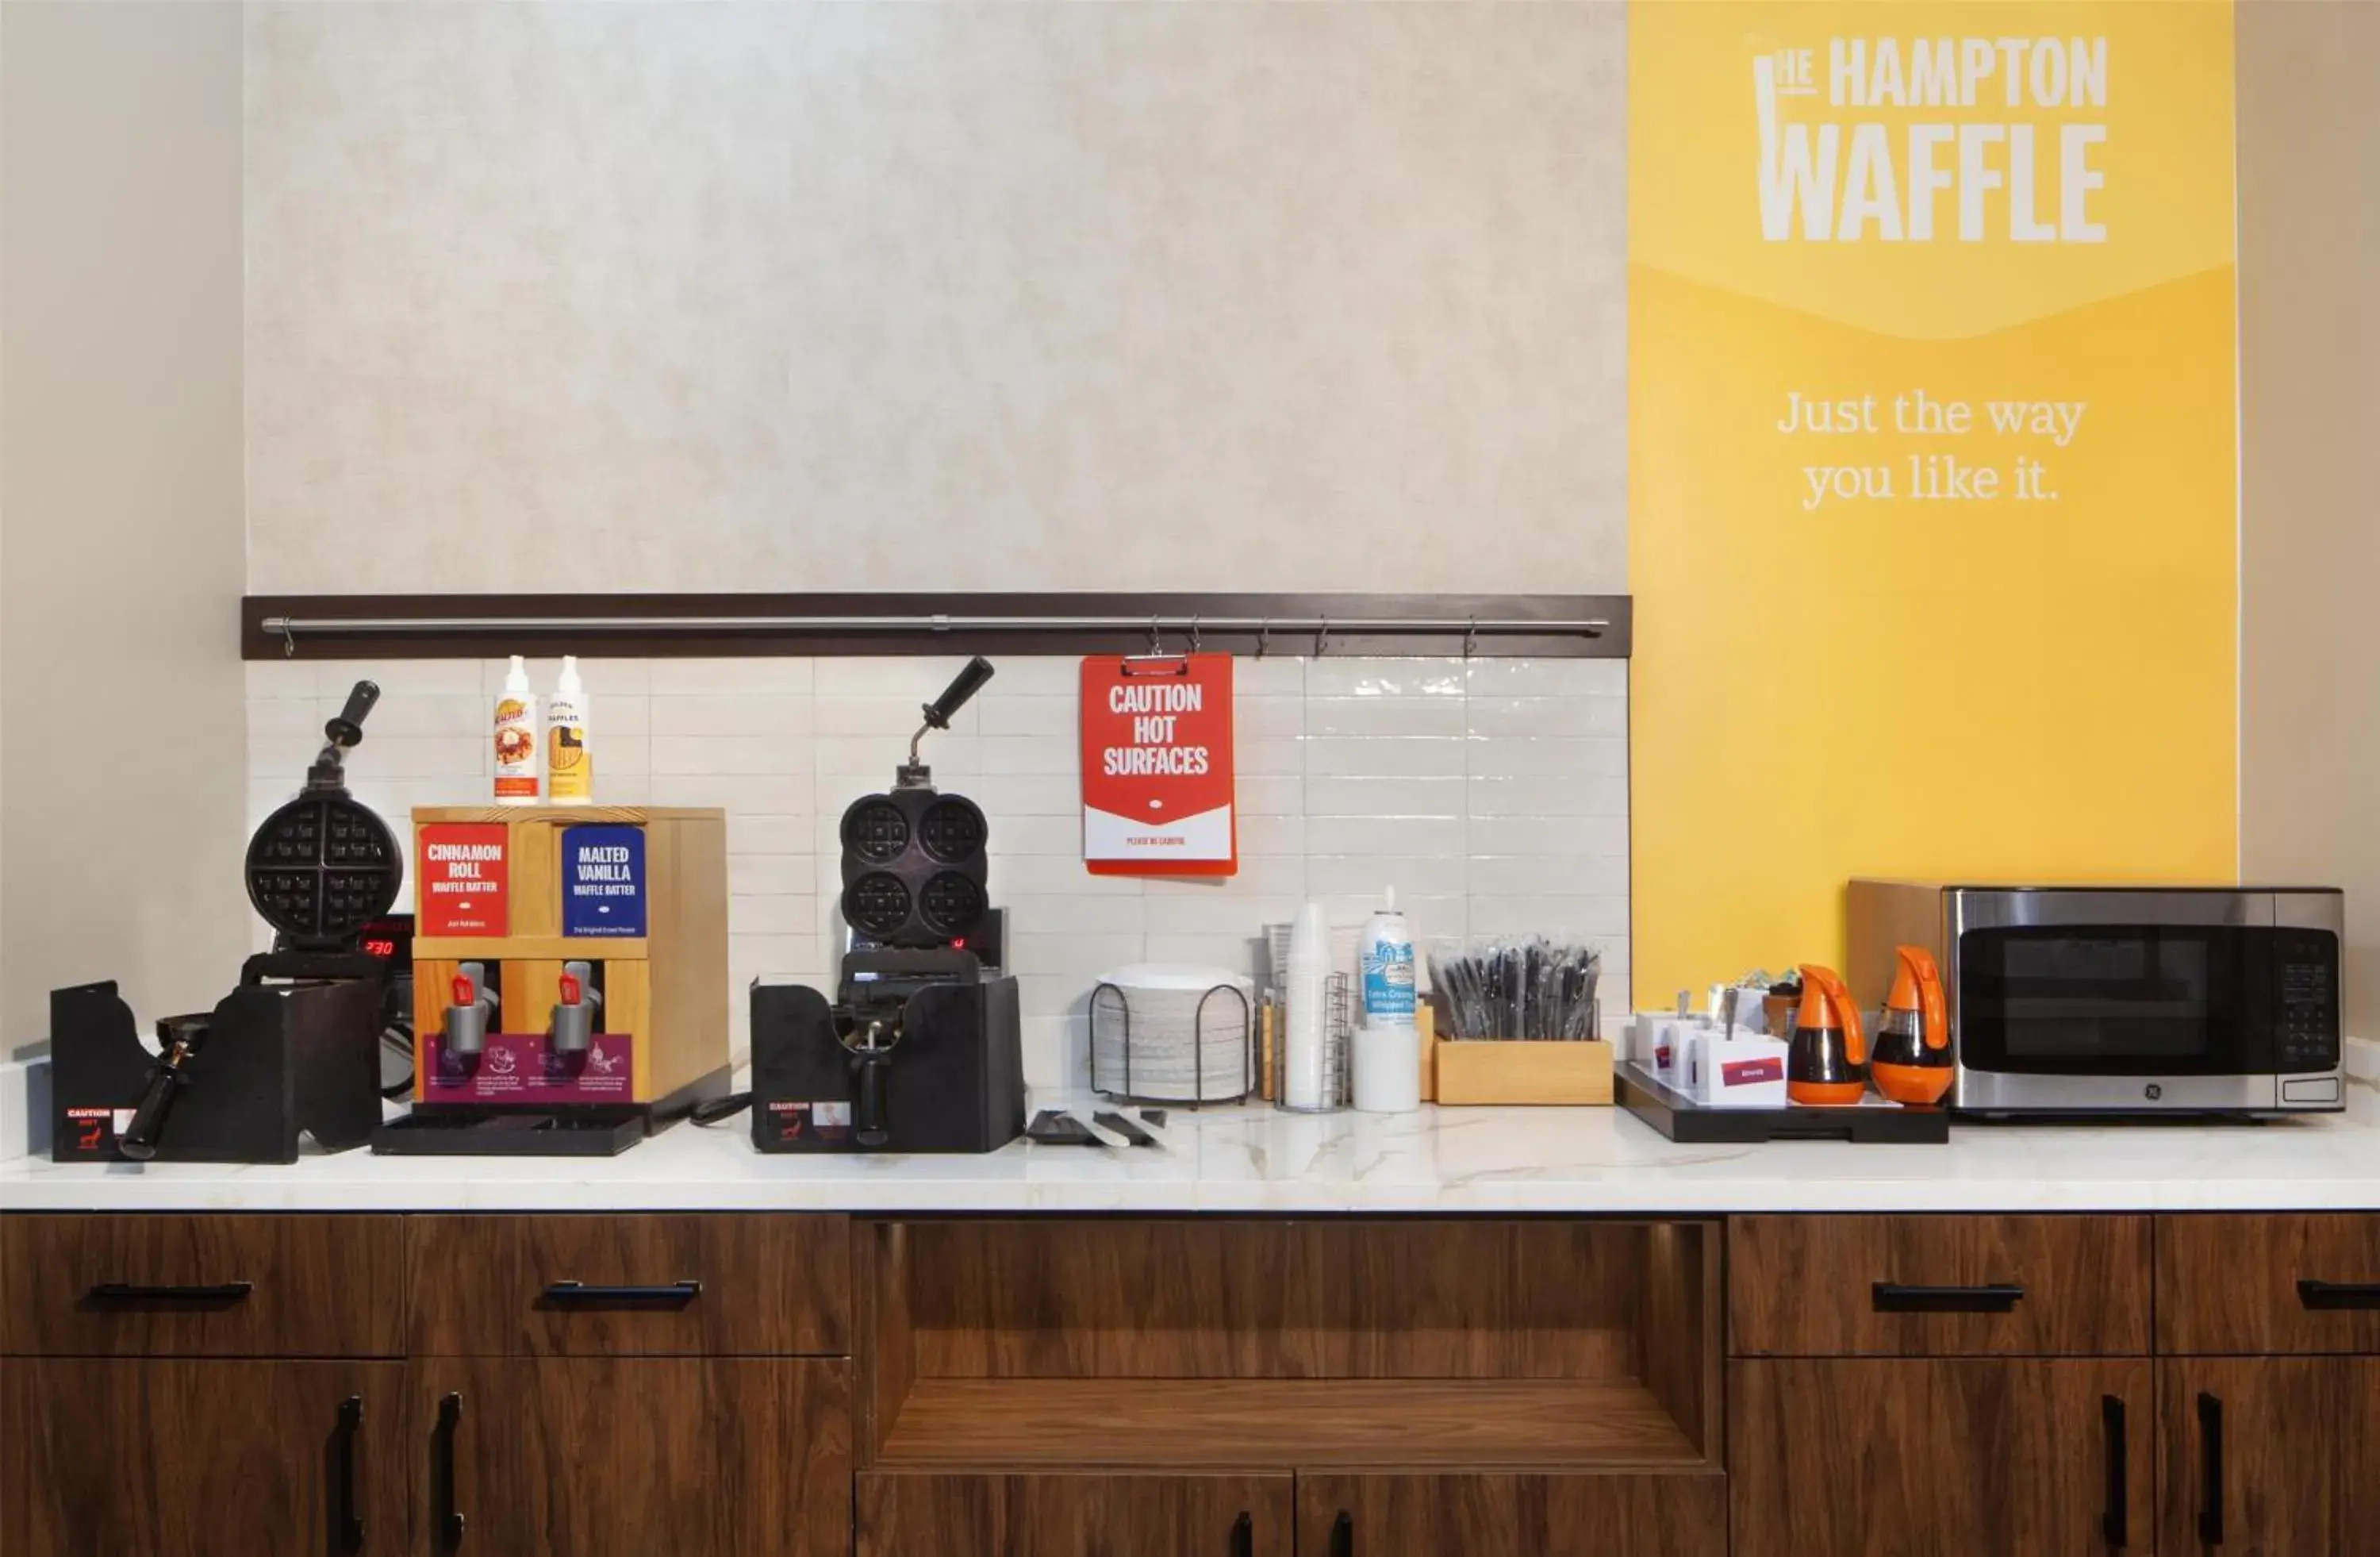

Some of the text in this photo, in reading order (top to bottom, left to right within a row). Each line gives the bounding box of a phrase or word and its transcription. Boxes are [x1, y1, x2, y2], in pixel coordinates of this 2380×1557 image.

[1829, 37, 2107, 107] HAMPTON
[1755, 122, 2108, 243] WAFFLE
[1777, 389, 2086, 446] Just the way
[1802, 456, 2059, 511] you like it.
[1109, 684, 1202, 713] CAUTION
[1134, 715, 1177, 744] HOT
[1104, 747, 1209, 775] SURFACES
[428, 844, 501, 861] CINNAMON
[578, 847, 629, 863] MALTED
[448, 862, 482, 878] ROLL
[578, 864, 631, 882] VANILLA
[432, 882, 497, 893] WAFFLE BATTER
[574, 885, 635, 895] WAFFLE BATTER
[67, 1109, 111, 1117] CAUTION
